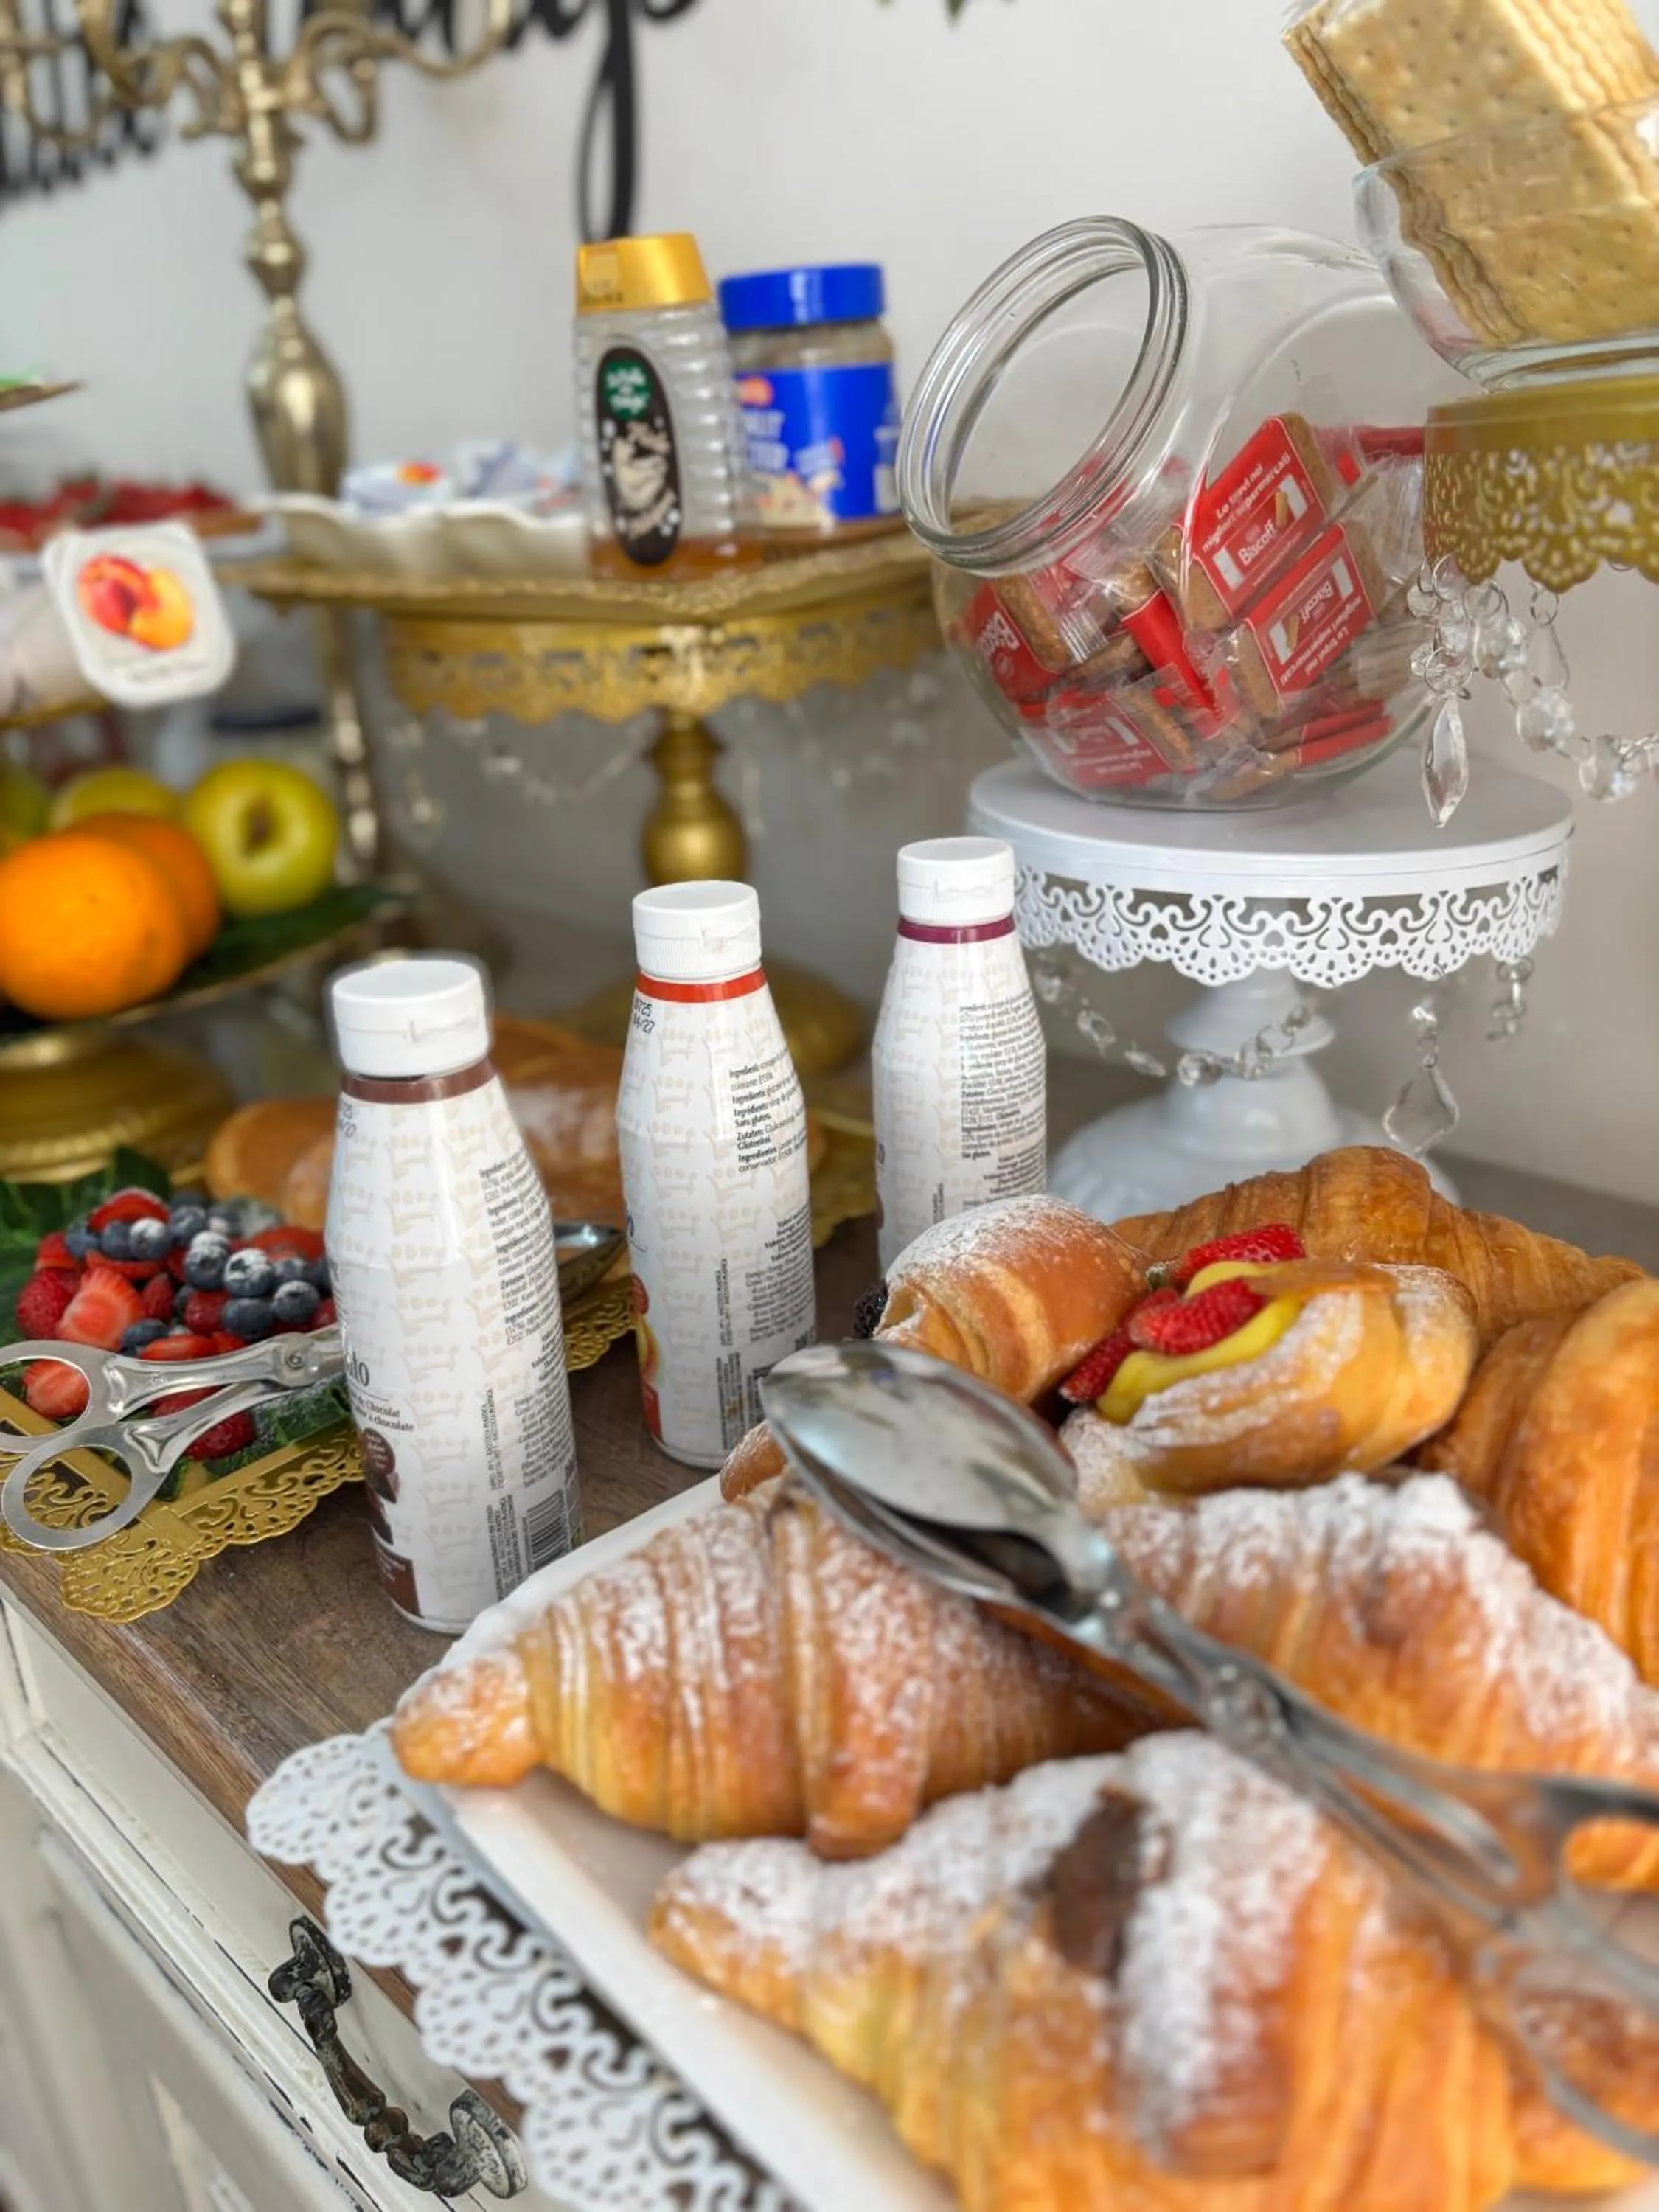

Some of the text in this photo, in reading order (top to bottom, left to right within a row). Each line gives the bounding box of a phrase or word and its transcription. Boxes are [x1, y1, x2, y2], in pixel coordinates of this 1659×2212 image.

[1202, 512, 1236, 553] migliori
[1235, 451, 1291, 518] supermercati
[1216, 504, 1230, 519] Lo
[1248, 463, 1264, 484] nei
[1239, 518, 1277, 566] Biscoff
[1299, 582, 1334, 624] Biscoff
[374, 1415, 416, 1433] chocolate
